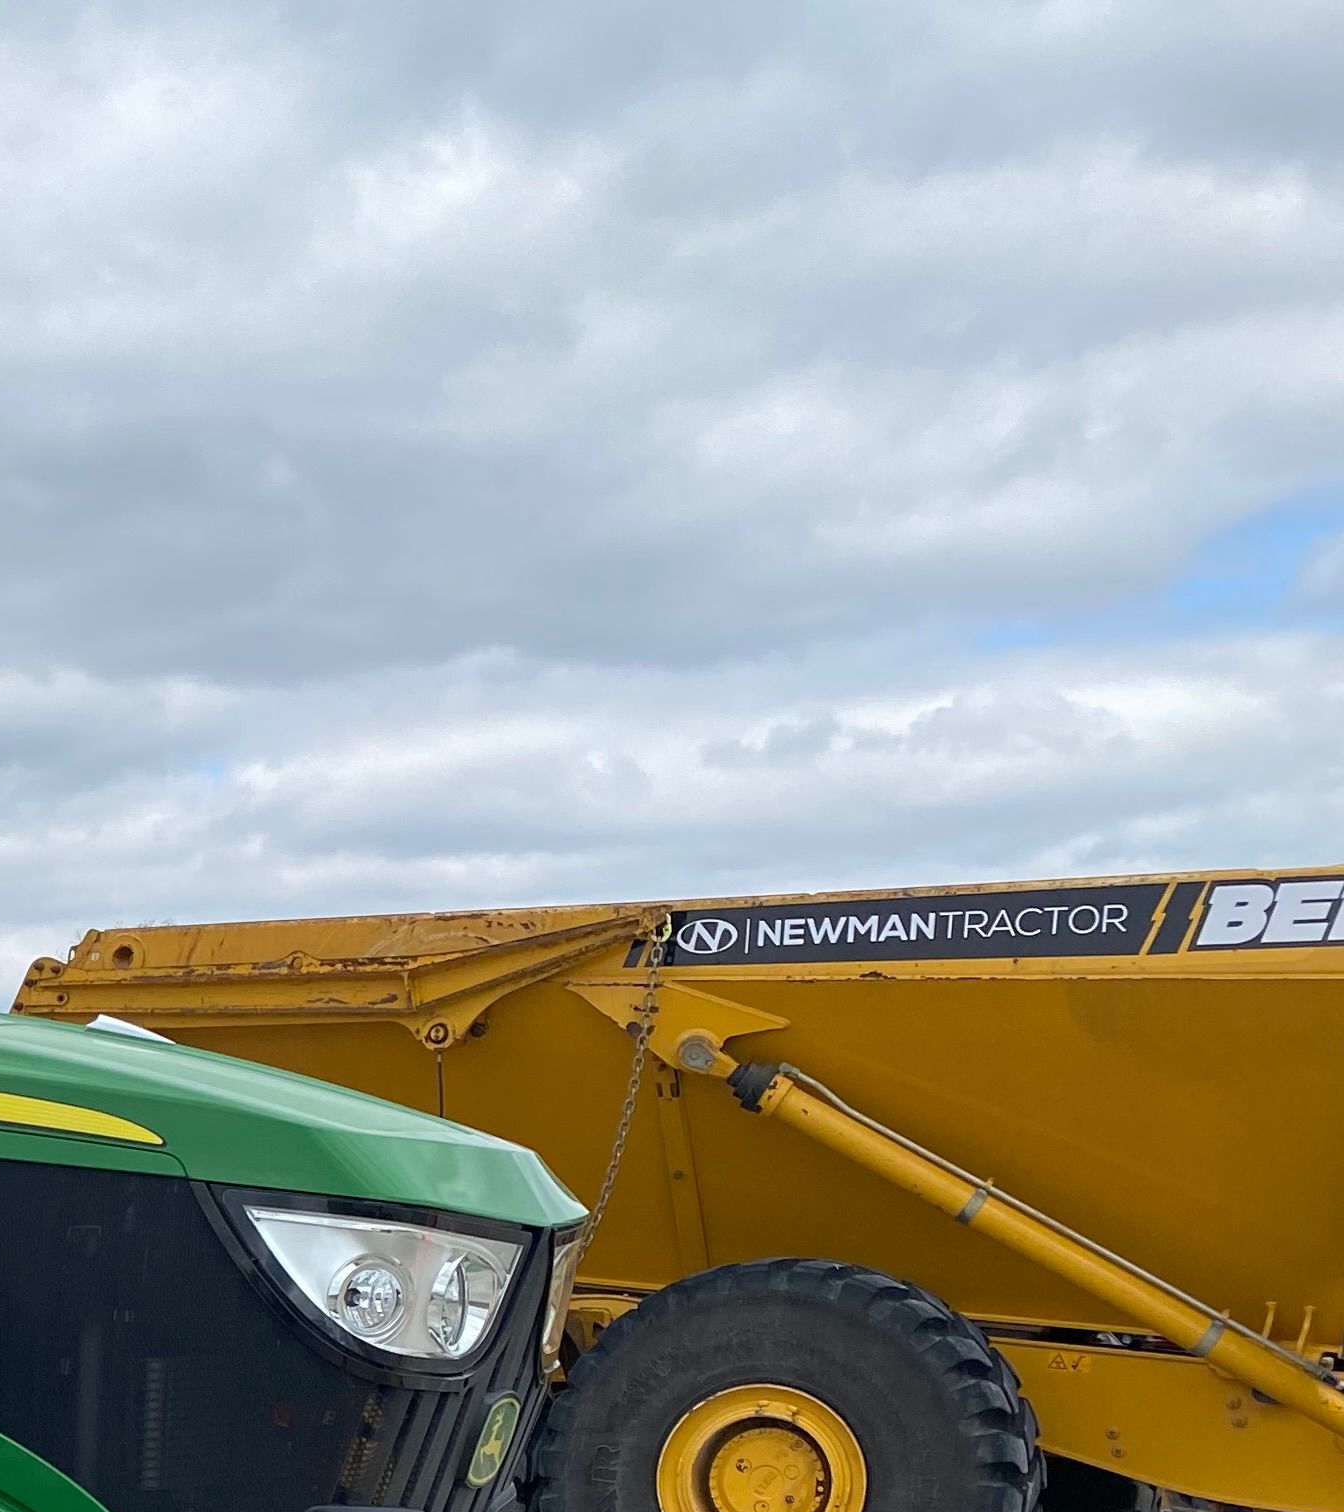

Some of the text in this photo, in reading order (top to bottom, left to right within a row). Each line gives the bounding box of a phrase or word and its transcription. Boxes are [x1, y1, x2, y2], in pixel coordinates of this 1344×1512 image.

[757, 913, 936, 947] NEWMAN
[939, 903, 1128, 940] TRACTOR
[1196, 880, 1344, 946] BE
